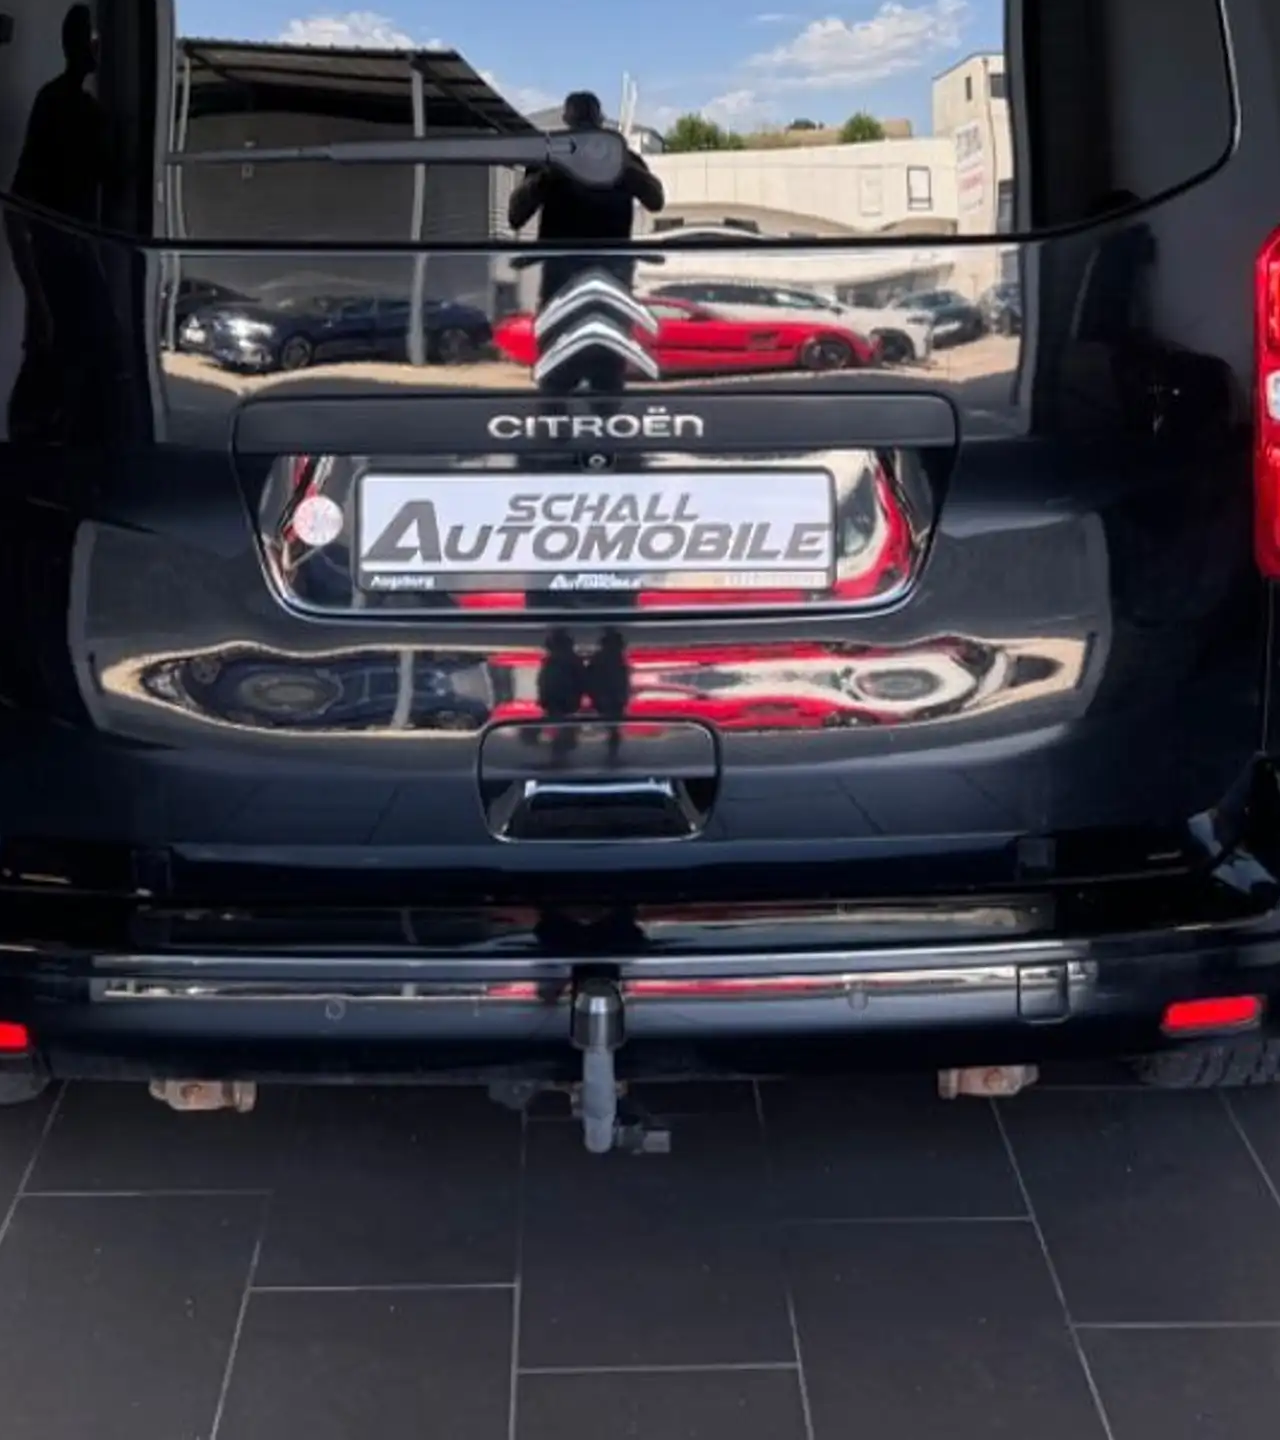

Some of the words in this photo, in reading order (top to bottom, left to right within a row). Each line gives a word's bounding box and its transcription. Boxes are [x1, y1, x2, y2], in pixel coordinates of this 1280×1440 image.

[487, 407, 705, 439] CITROËN
[506, 492, 700, 523] SCHALL
[362, 499, 831, 563] AUTOMOBILE
